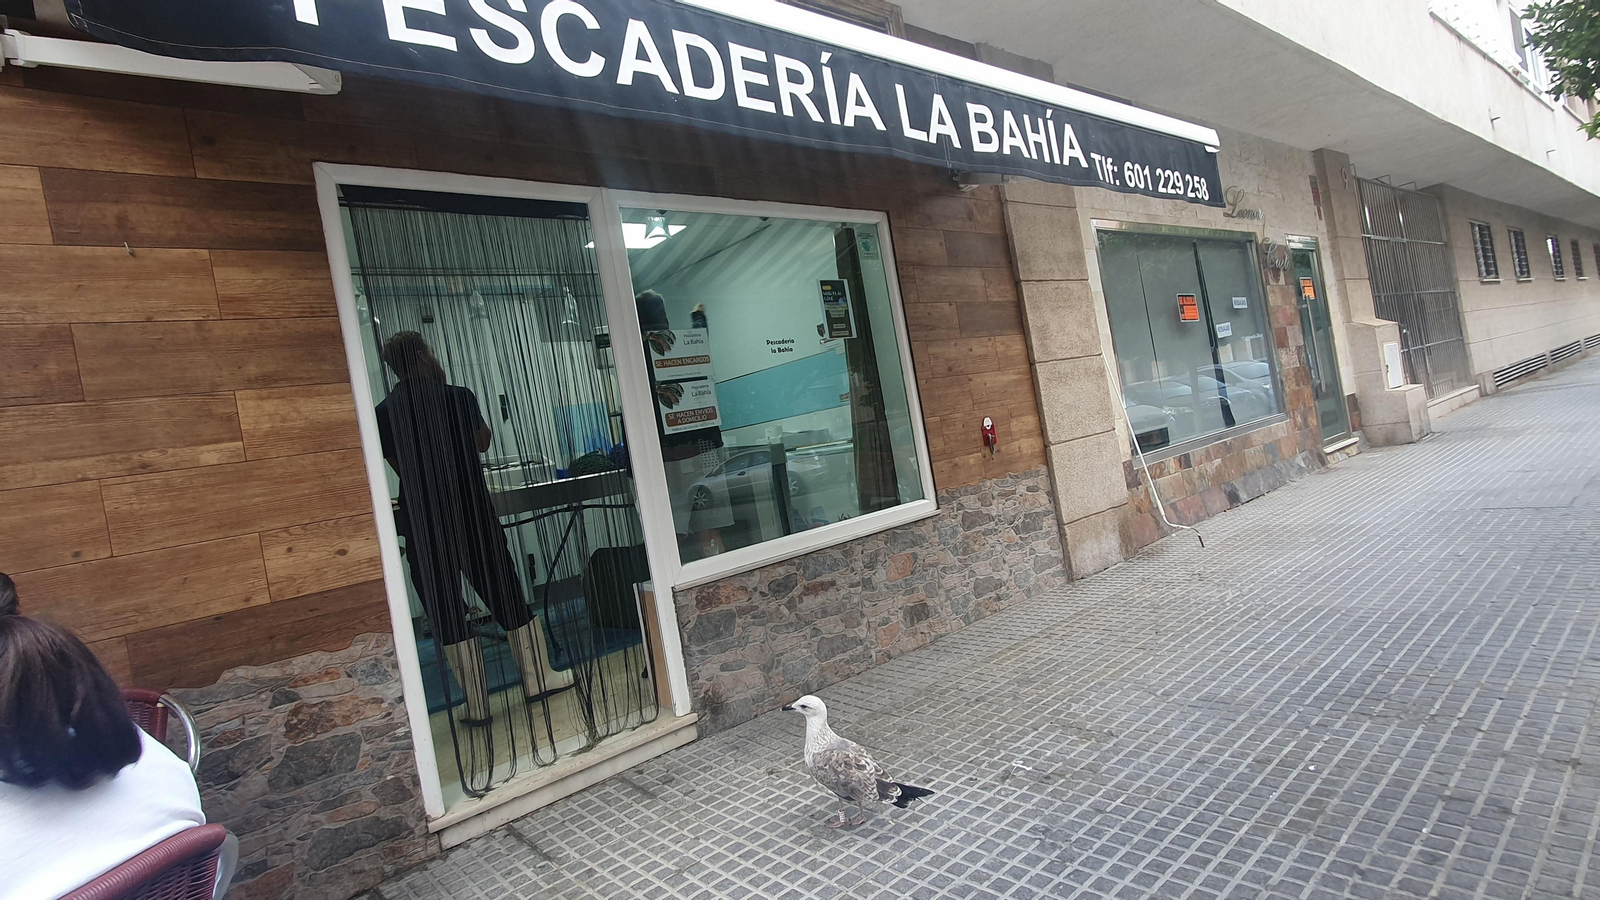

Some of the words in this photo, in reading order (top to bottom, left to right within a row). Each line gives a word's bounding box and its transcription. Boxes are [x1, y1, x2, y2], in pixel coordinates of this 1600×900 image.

[895, 83, 962, 149] LA
[966, 102, 1089, 169] BAHÍA
[1090, 152, 1120, 186] Tlf:
[1123, 161, 1153, 191] 601
[1155, 167, 1185, 195] 229
[1185, 173, 1210, 201] 258
[1340, 167, 1349, 190] 9
[655, 360, 663, 368] SE
[663, 359, 682, 367] HACEN
[682, 356, 710, 365] ENCARGOS
[682, 415, 708, 424] DOMICILIO
